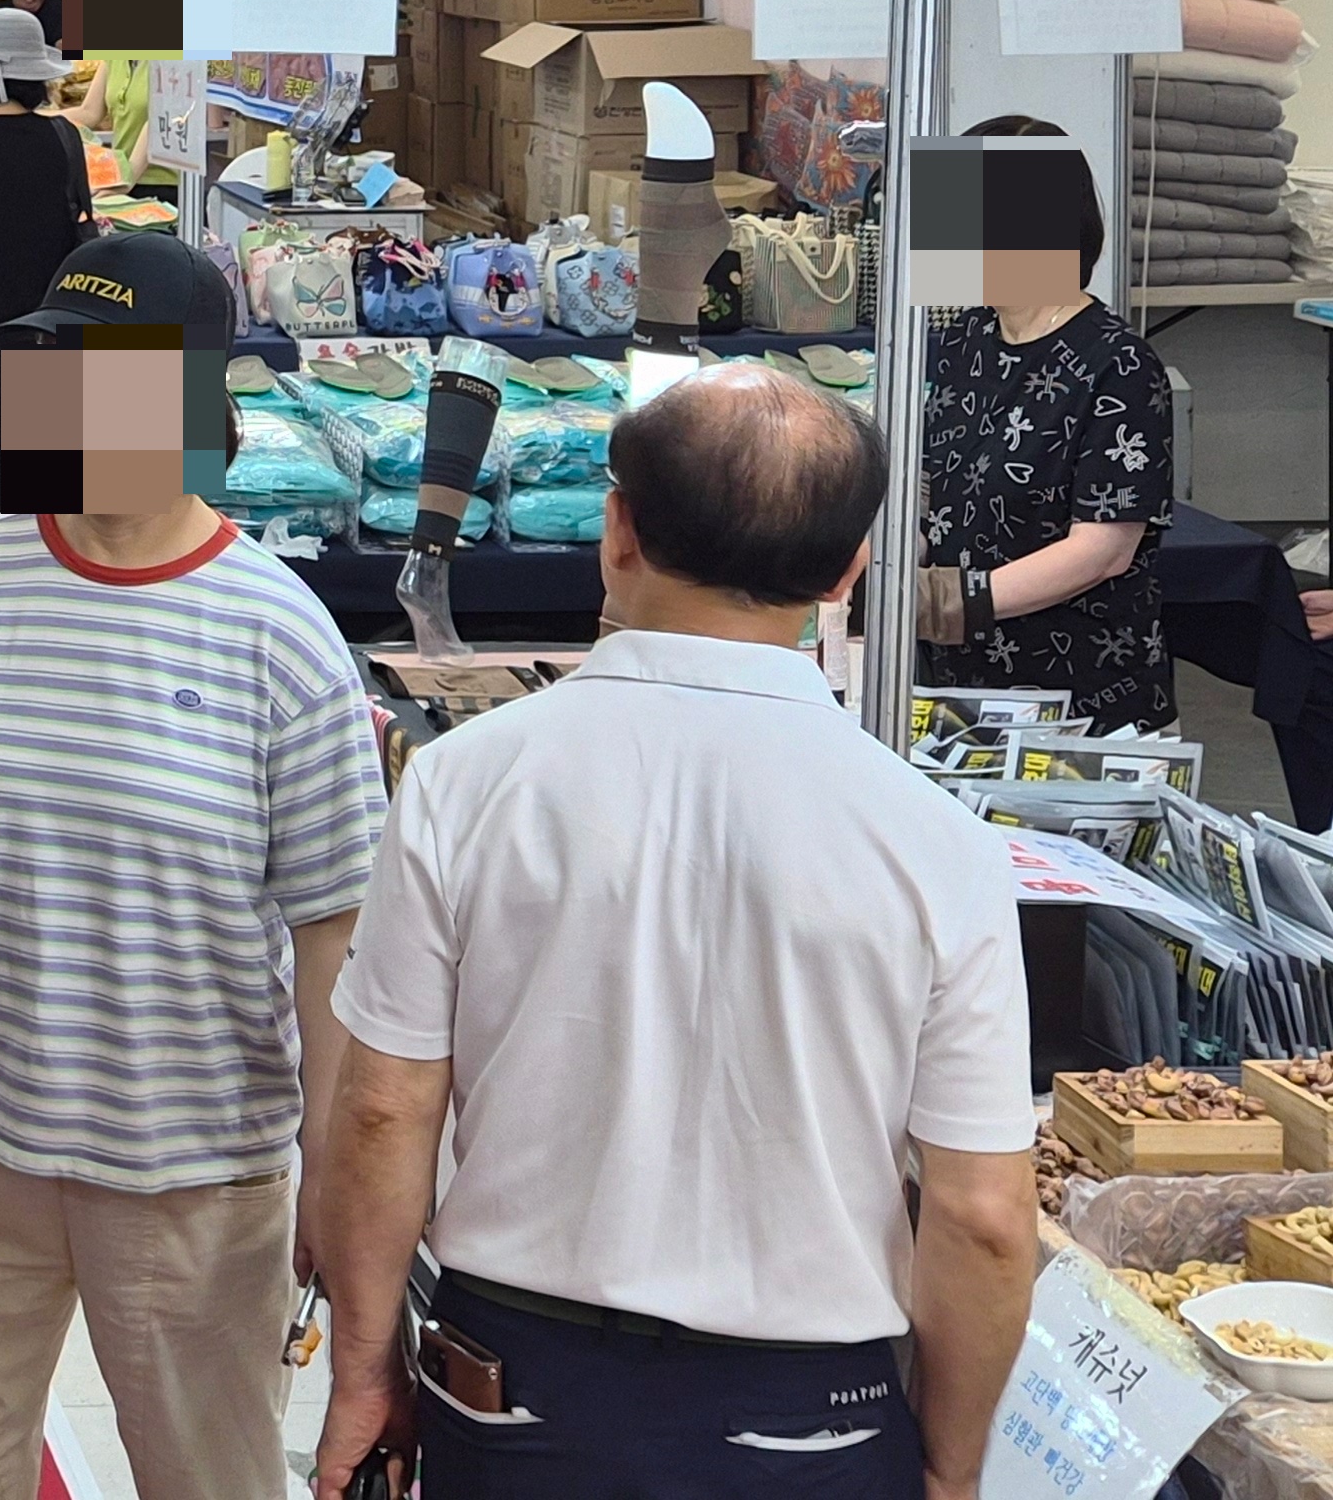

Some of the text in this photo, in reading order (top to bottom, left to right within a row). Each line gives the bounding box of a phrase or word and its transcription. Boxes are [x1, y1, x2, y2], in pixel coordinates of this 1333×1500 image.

[158, 110, 190, 153] 만원
[55, 271, 134, 309] ARITZIA
[1068, 1325, 1148, 1404] 캐슈넛
[1020, 1370, 1064, 1416] 고단백
[1002, 1411, 1045, 1457] 심혈관
